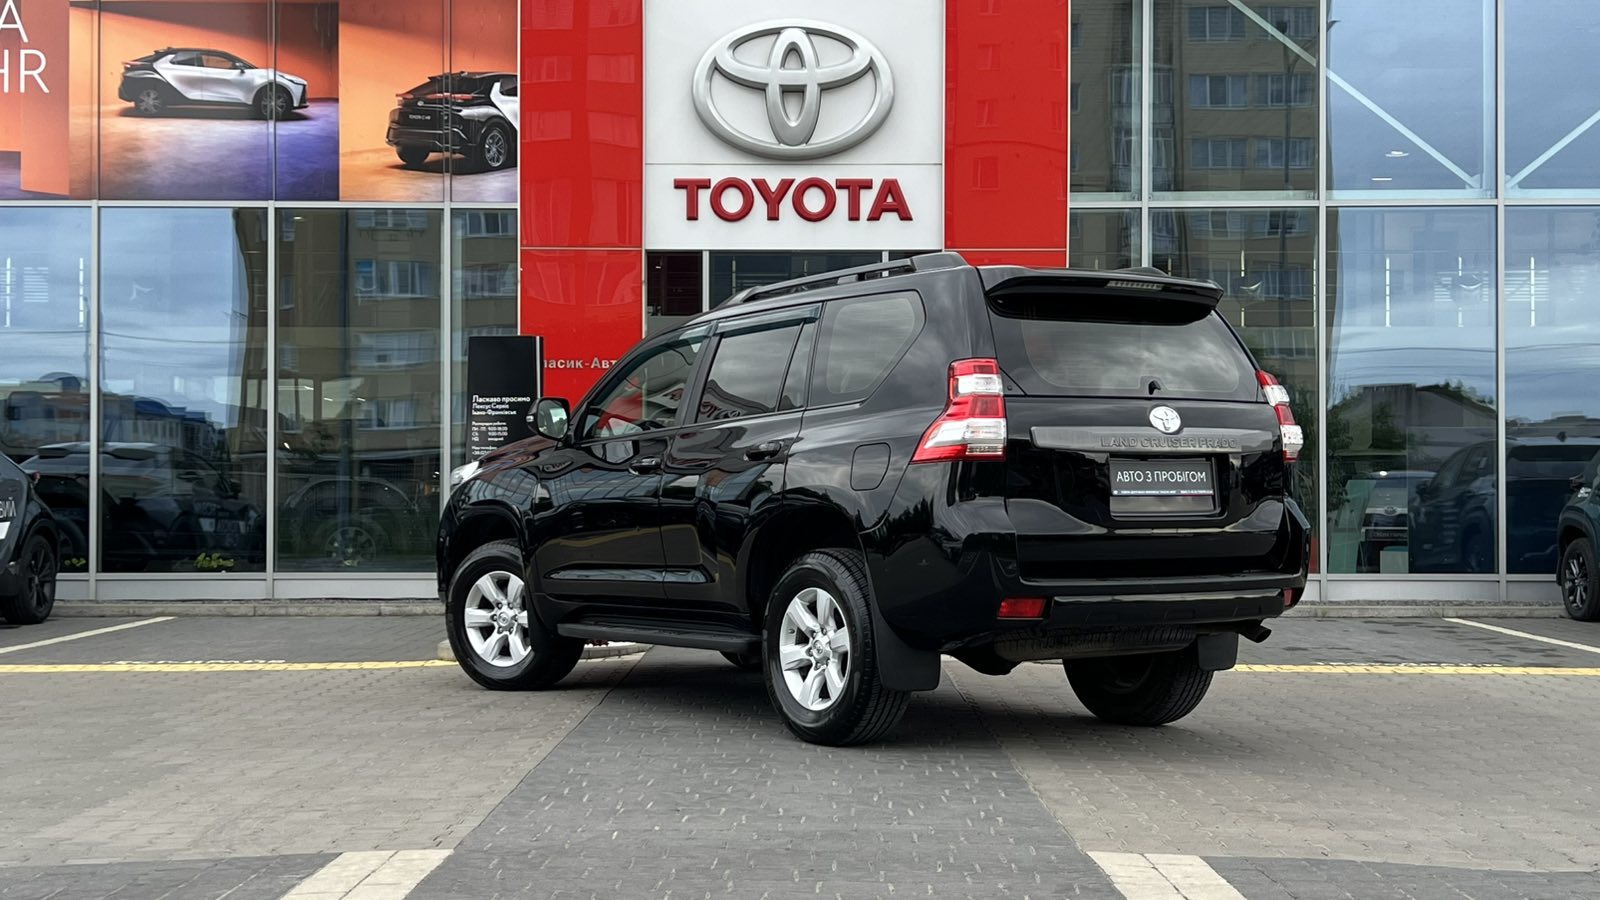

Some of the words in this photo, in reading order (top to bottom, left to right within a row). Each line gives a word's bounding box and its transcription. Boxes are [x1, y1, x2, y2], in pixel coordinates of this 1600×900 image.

[673, 176, 913, 222] TOYOTA
[1101, 436, 1138, 448] LAND
[1140, 437, 1196, 448] CRUISER
[1198, 438, 1237, 449] PRADO
[1116, 471, 1144, 482] АВТО
[1154, 471, 1207, 482] ПРОБІГОМ
